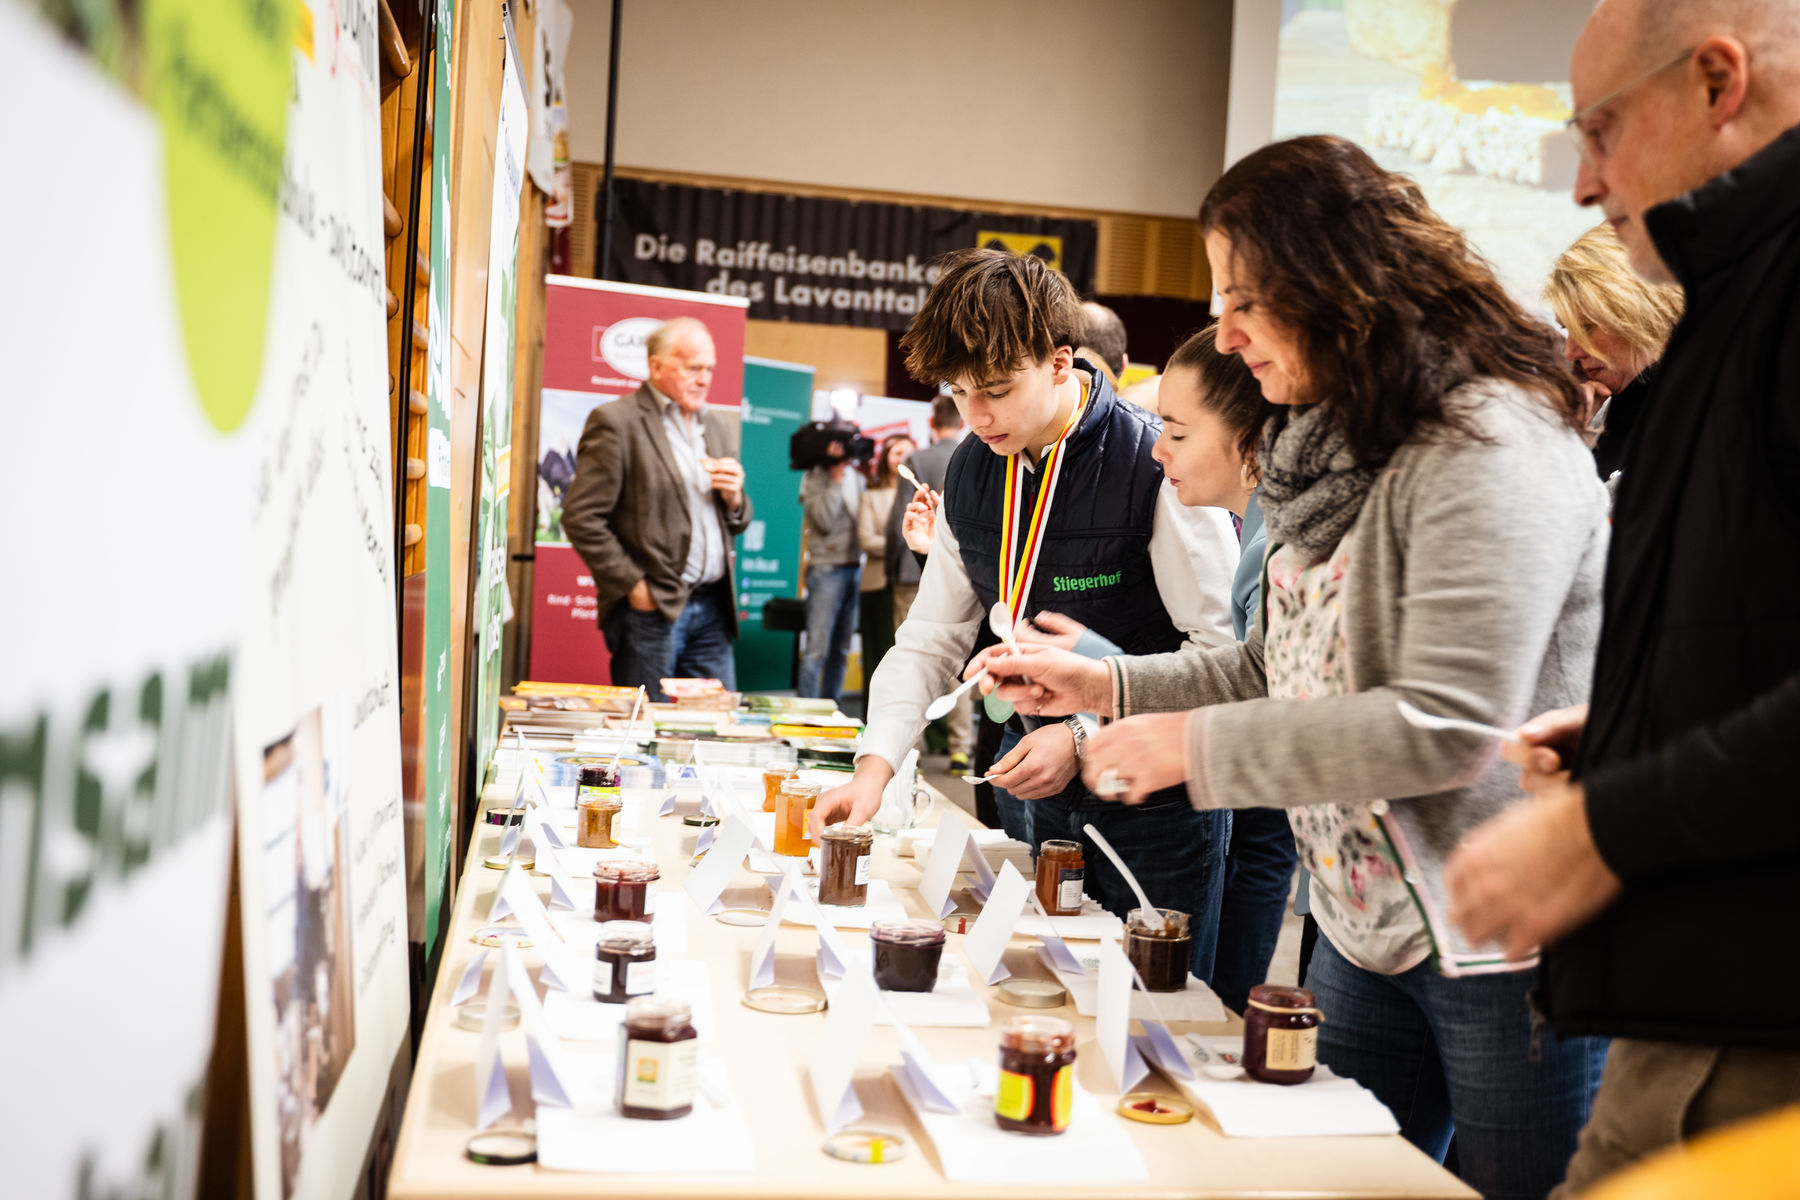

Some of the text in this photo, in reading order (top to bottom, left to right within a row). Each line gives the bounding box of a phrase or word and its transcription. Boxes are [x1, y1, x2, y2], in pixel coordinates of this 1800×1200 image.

[634, 233, 687, 263] Die
[706, 269, 766, 303] des
[1053, 570, 1121, 592] Stiegerhof
